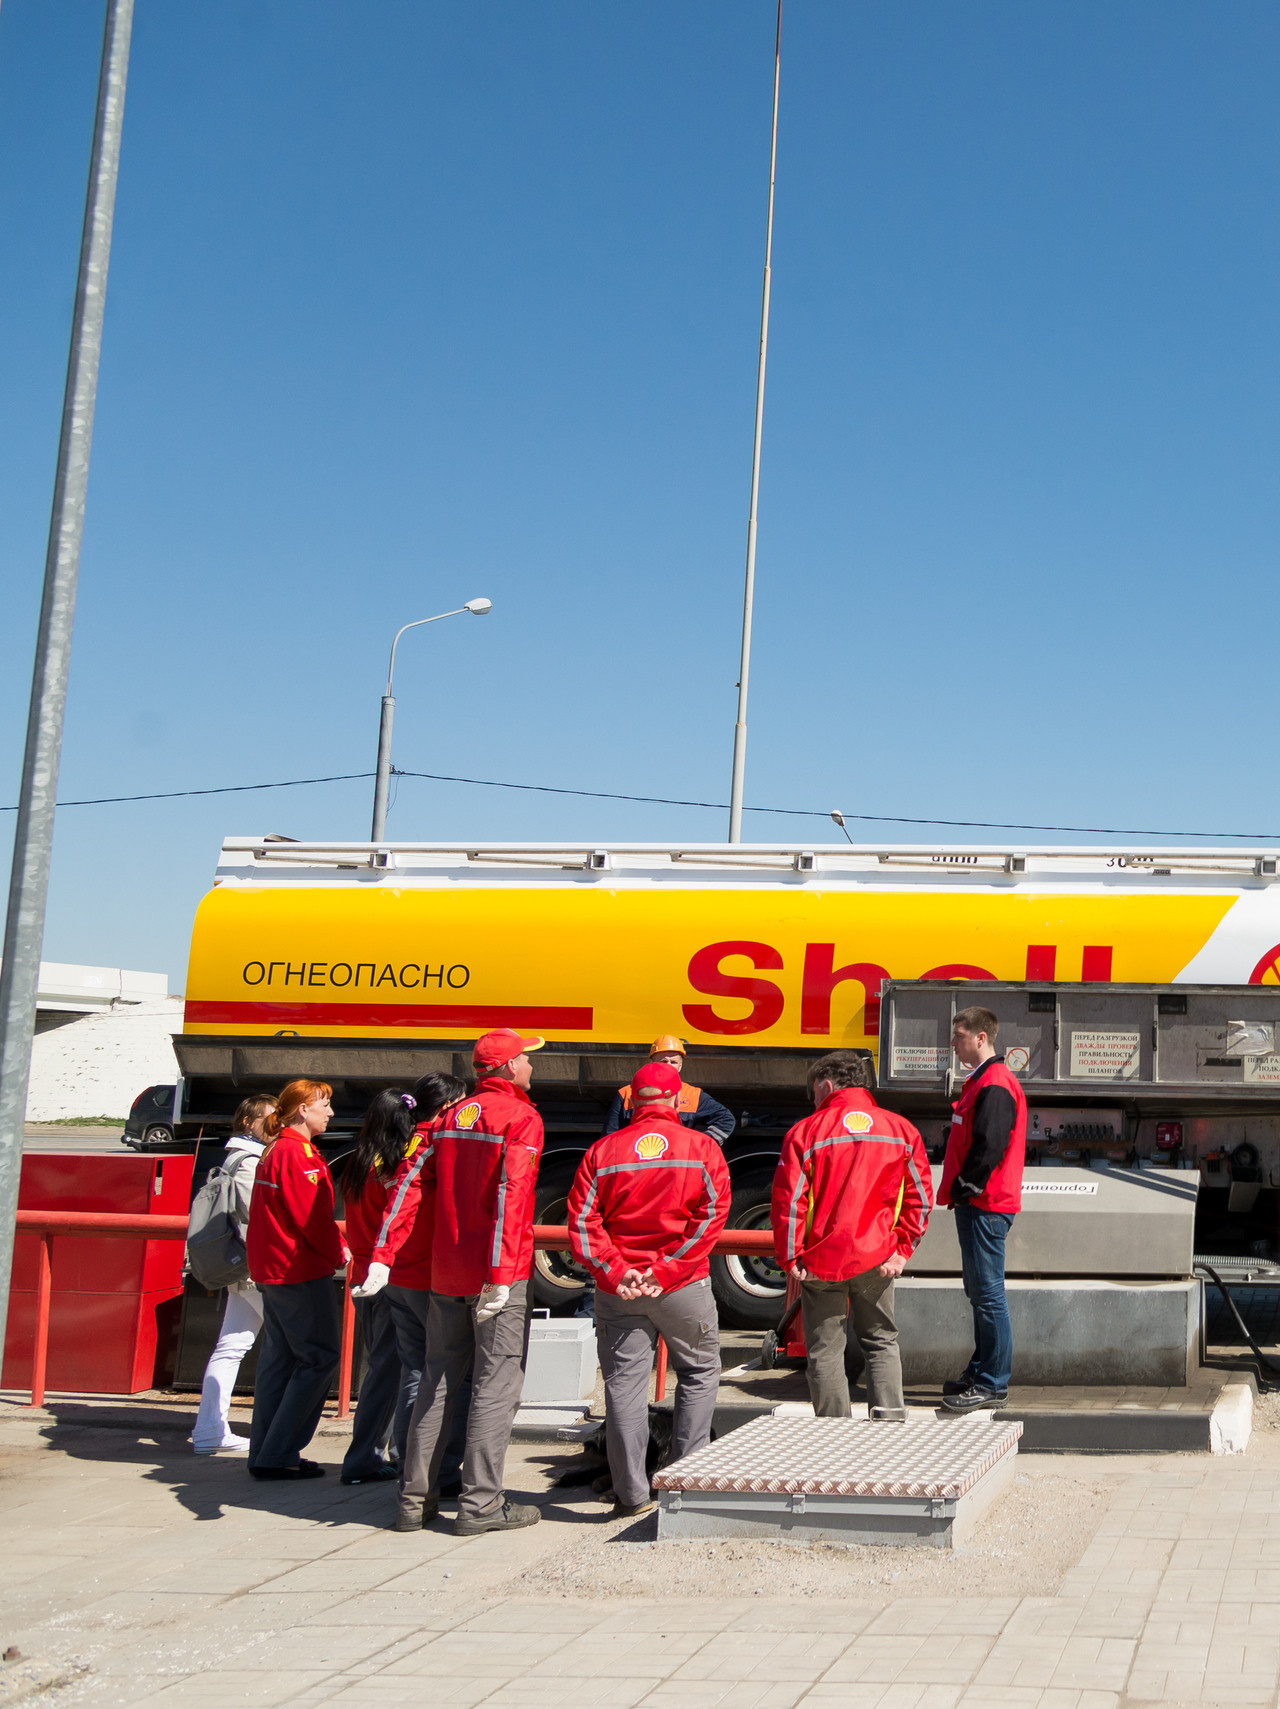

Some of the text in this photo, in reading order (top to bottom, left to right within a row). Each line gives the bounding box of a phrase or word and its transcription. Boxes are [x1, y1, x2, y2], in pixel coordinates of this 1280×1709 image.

[242, 961, 471, 989] ОГНЕОПАСНО
[1096, 1034, 1138, 1042] РАЗГРУЗКОЙ
[1074, 1042, 1105, 1050] ДВАЖДЫ
[1021, 1184, 1095, 1193] Горловин
